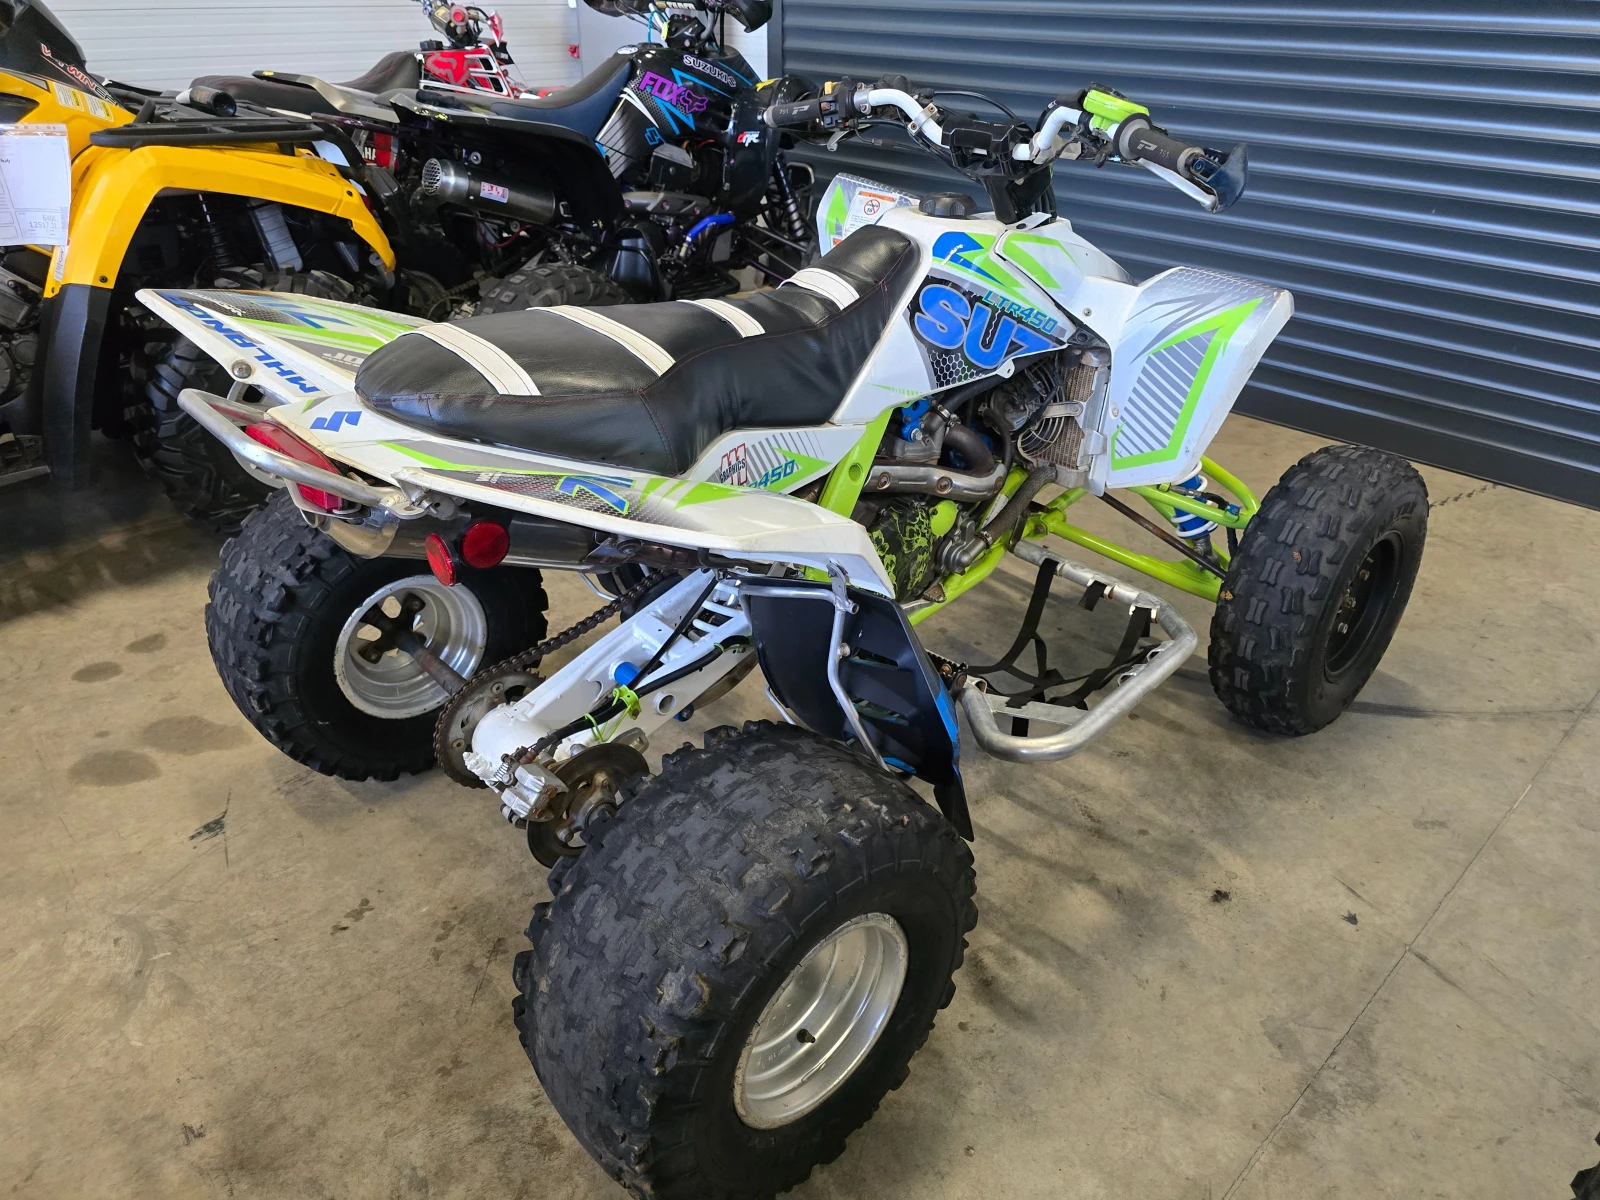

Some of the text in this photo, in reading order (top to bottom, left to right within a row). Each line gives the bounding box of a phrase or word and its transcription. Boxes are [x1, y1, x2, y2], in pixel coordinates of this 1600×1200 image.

[683, 54, 729, 84] SUZUKI
[638, 71, 686, 106] FOX
[981, 290, 1058, 335] LTR450
[720, 457, 746, 484] GRAPHICS
